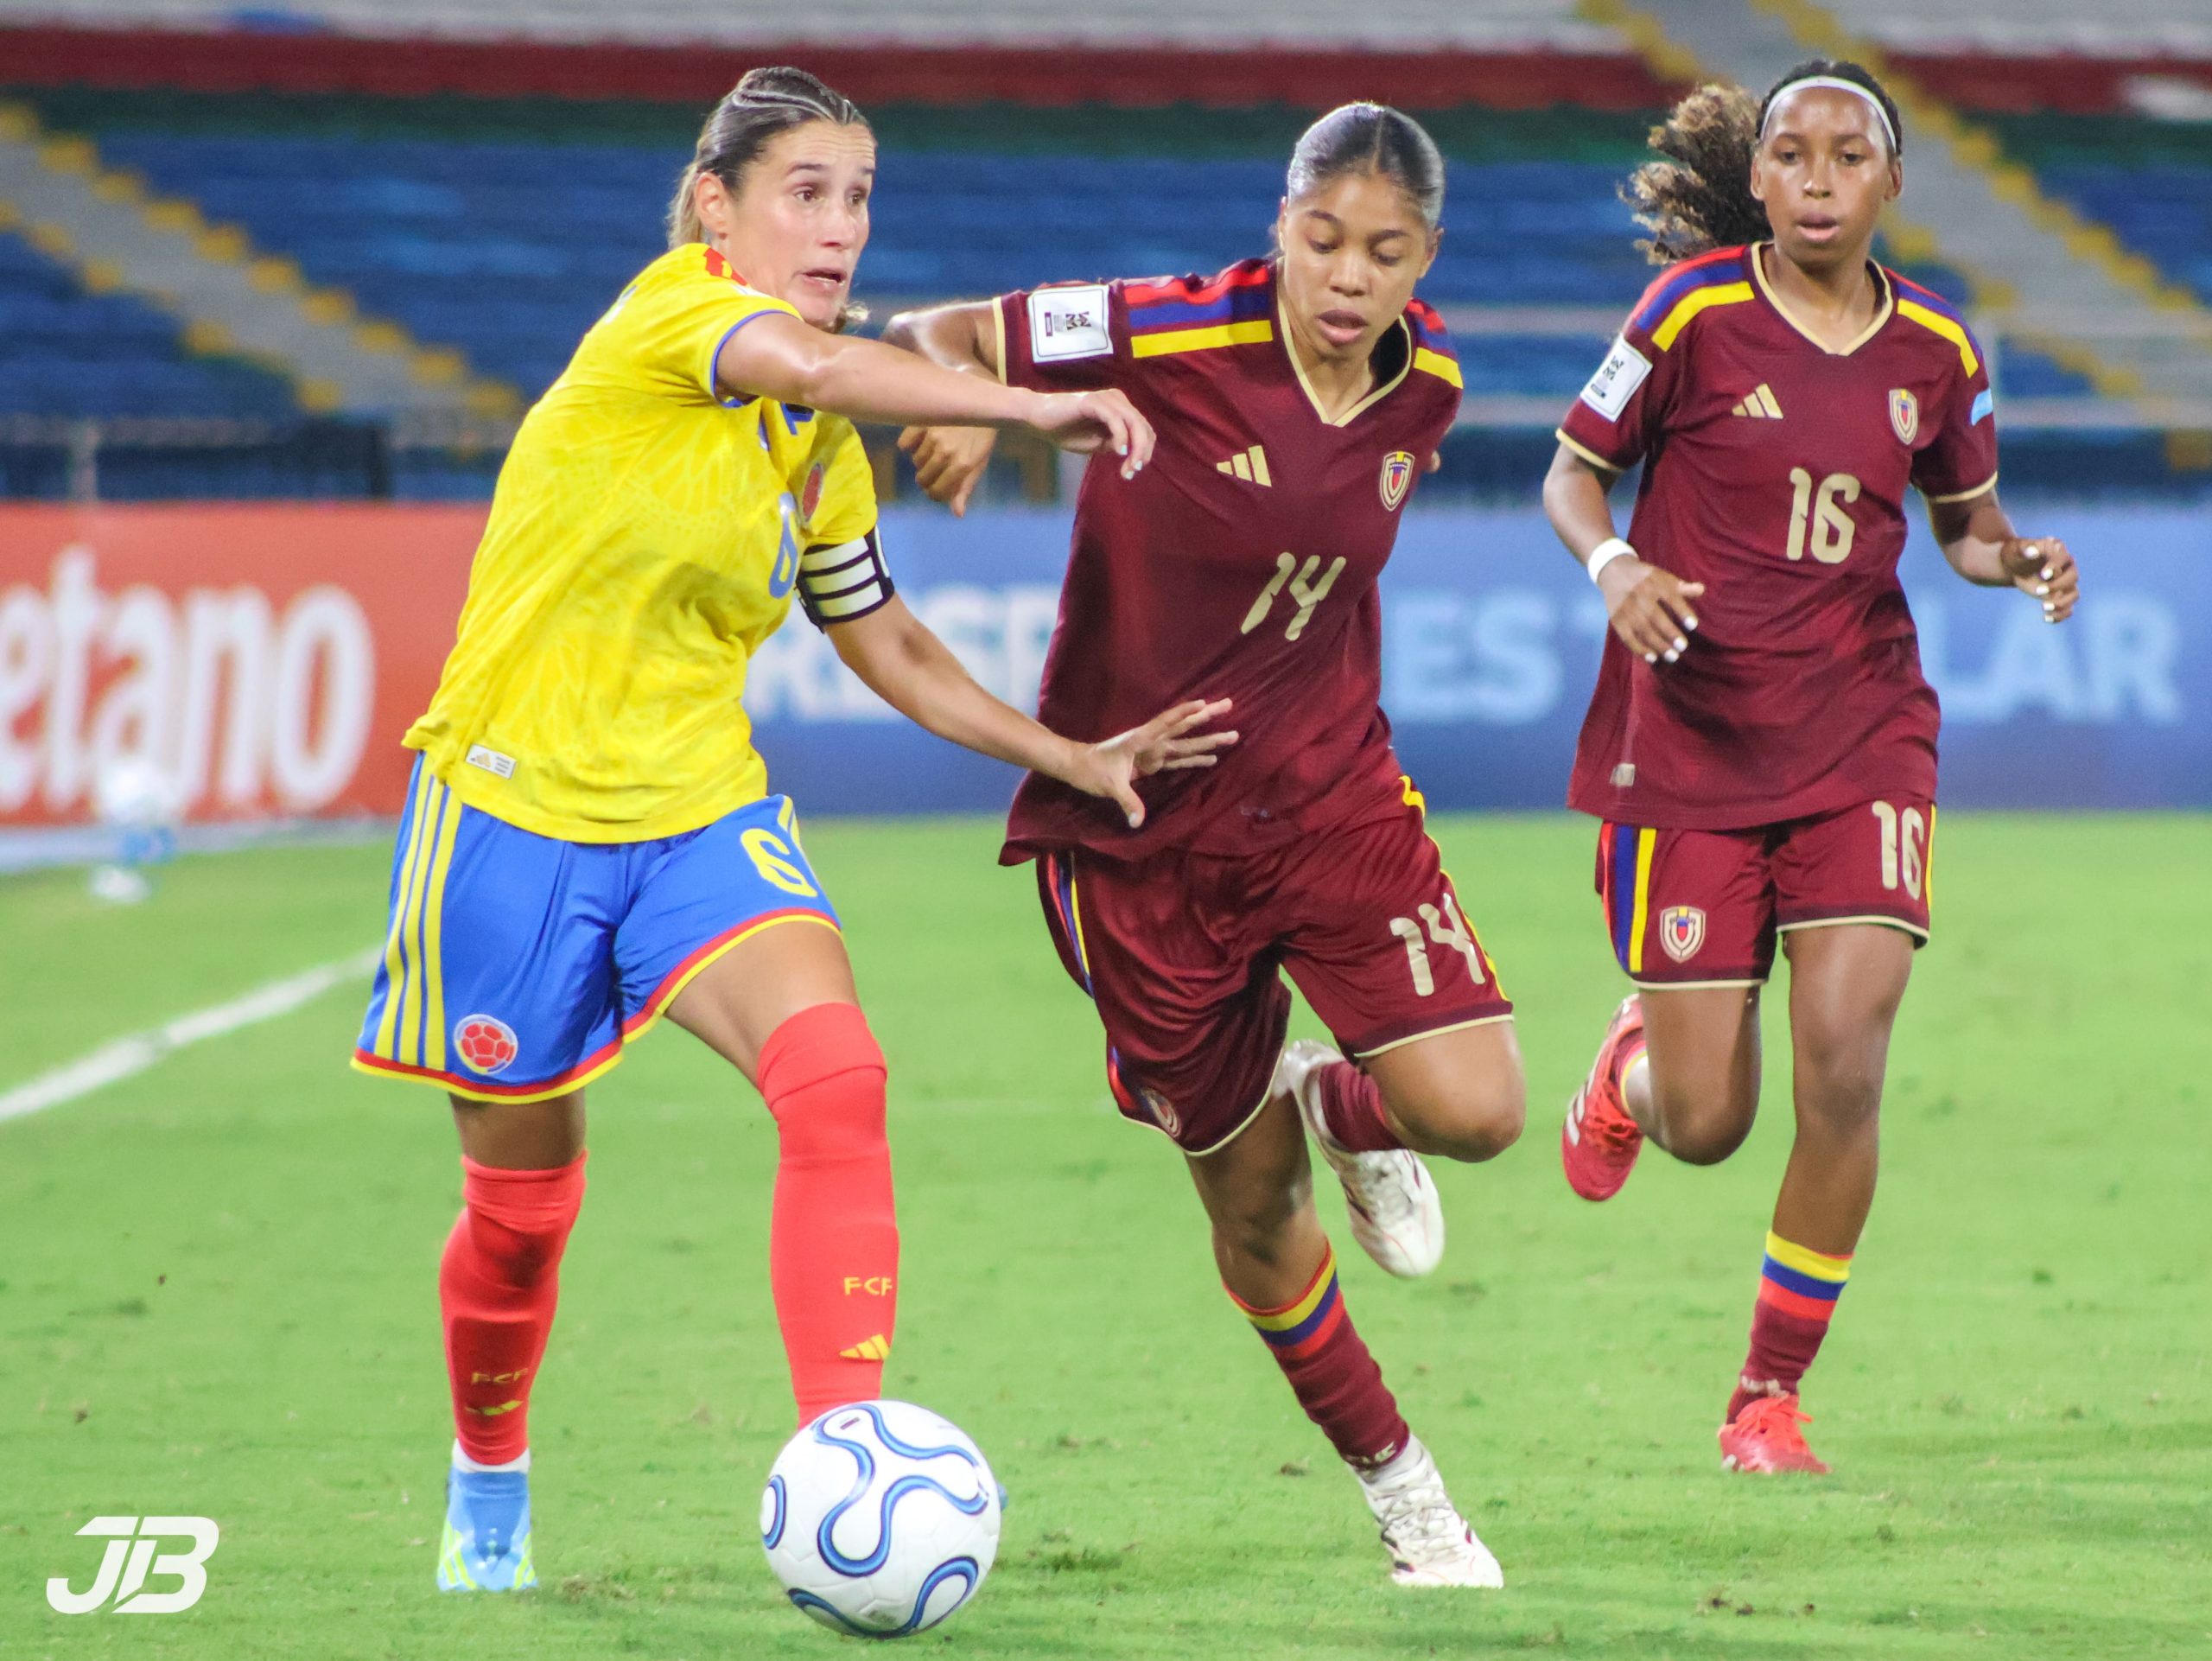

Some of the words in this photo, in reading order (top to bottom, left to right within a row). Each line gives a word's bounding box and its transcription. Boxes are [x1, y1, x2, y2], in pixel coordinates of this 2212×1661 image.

[1786, 468, 1860, 565] 16
[1241, 551, 1347, 640] 14
[741, 828, 818, 897] 6
[1871, 800, 1924, 901] 16
[1389, 893, 1486, 996] 14
[843, 1276, 893, 1296] FCF
[471, 1368, 529, 1384] FCF
